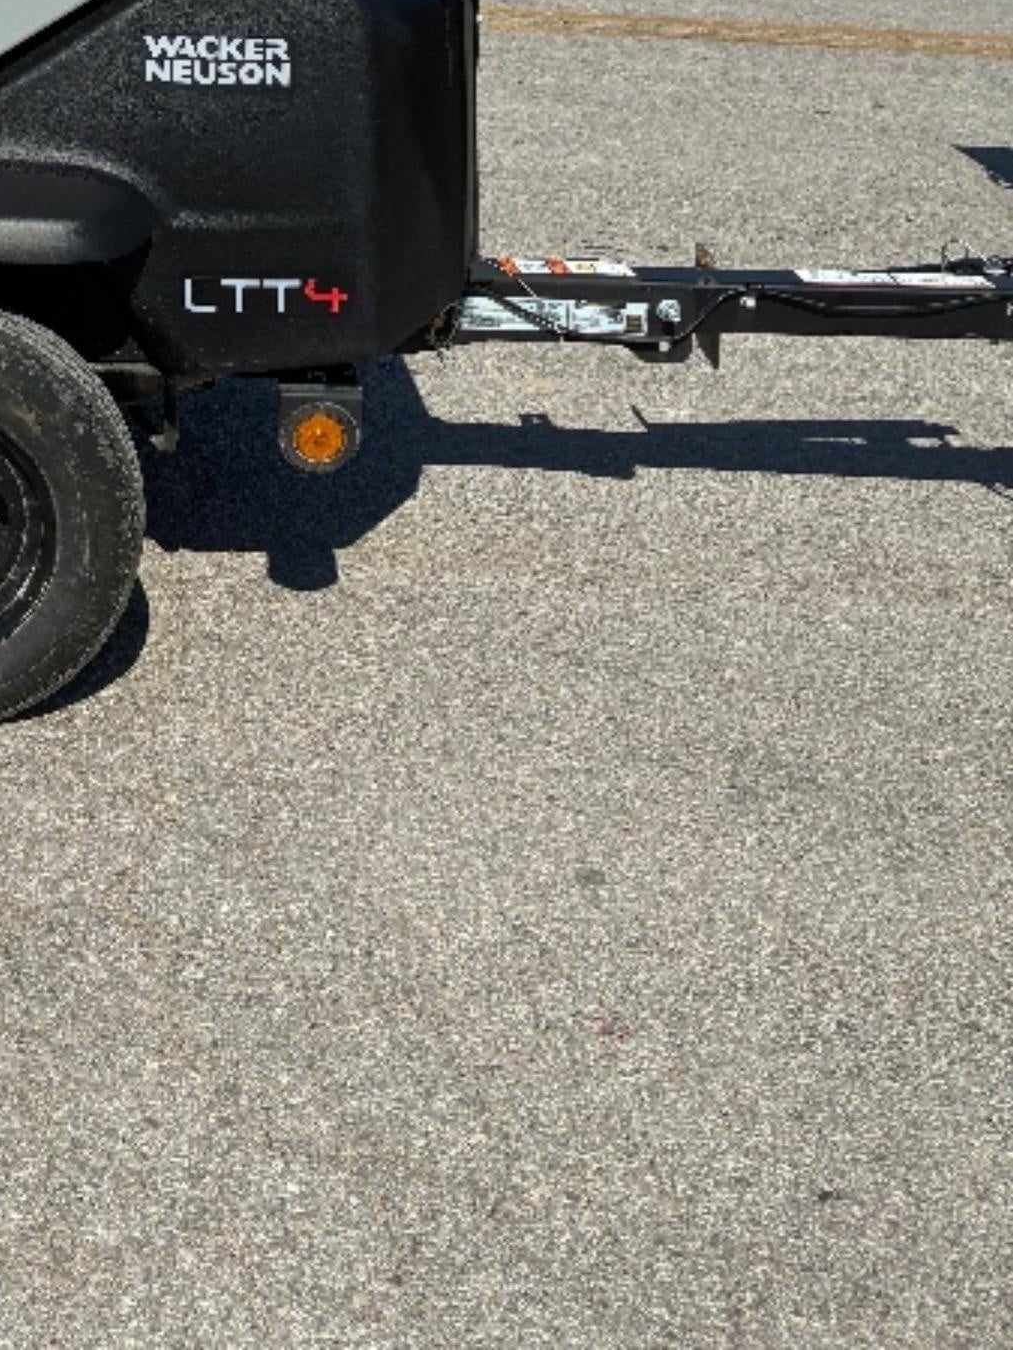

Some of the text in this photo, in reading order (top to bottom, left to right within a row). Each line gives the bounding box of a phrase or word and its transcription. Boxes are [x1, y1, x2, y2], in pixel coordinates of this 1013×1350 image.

[143, 35, 291, 61] WACKER
[144, 59, 292, 87] NEUSON
[184, 277, 349, 314] LTT4
